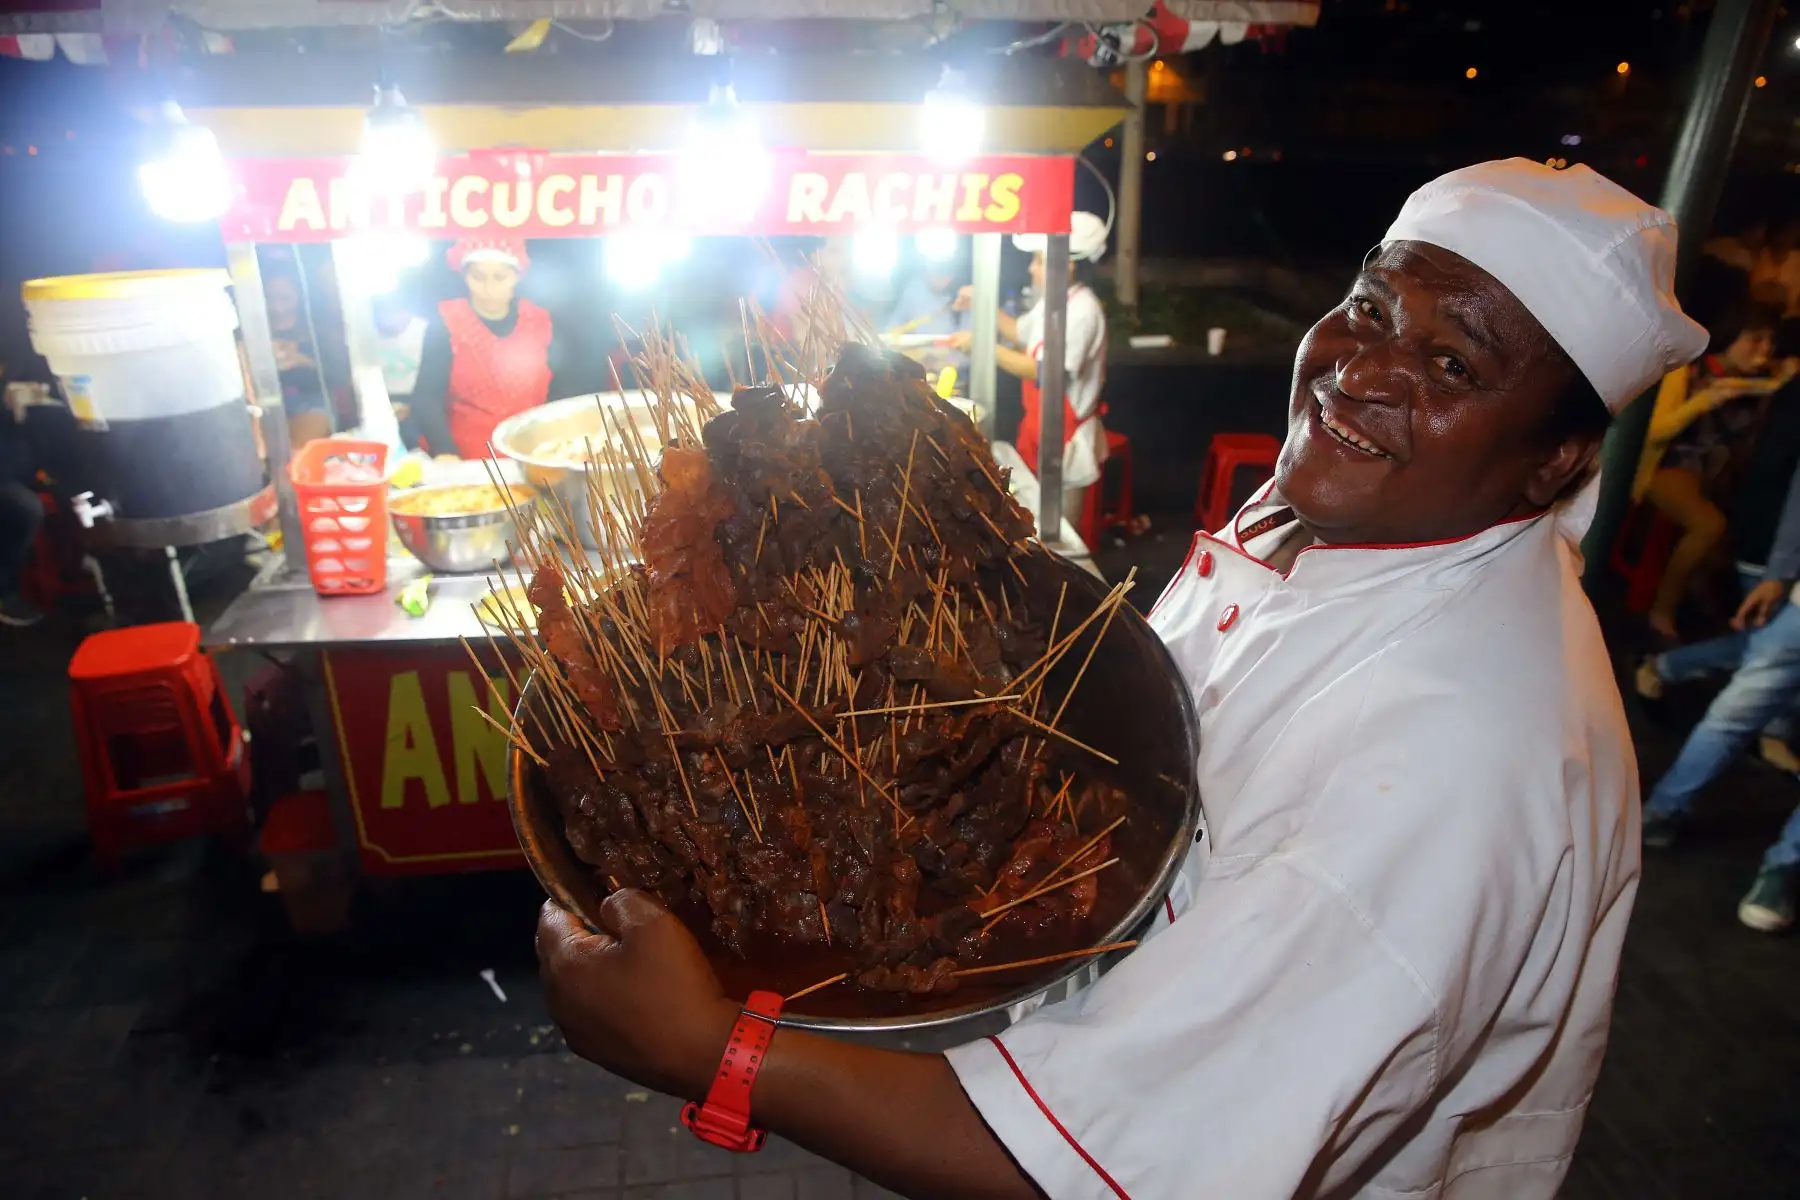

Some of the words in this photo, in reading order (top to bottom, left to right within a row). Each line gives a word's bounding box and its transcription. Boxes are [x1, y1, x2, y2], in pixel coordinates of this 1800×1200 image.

[278, 173, 700, 231] ANTICUCHO
[787, 172, 1025, 223] RACHIS
[381, 667, 532, 809] AN
